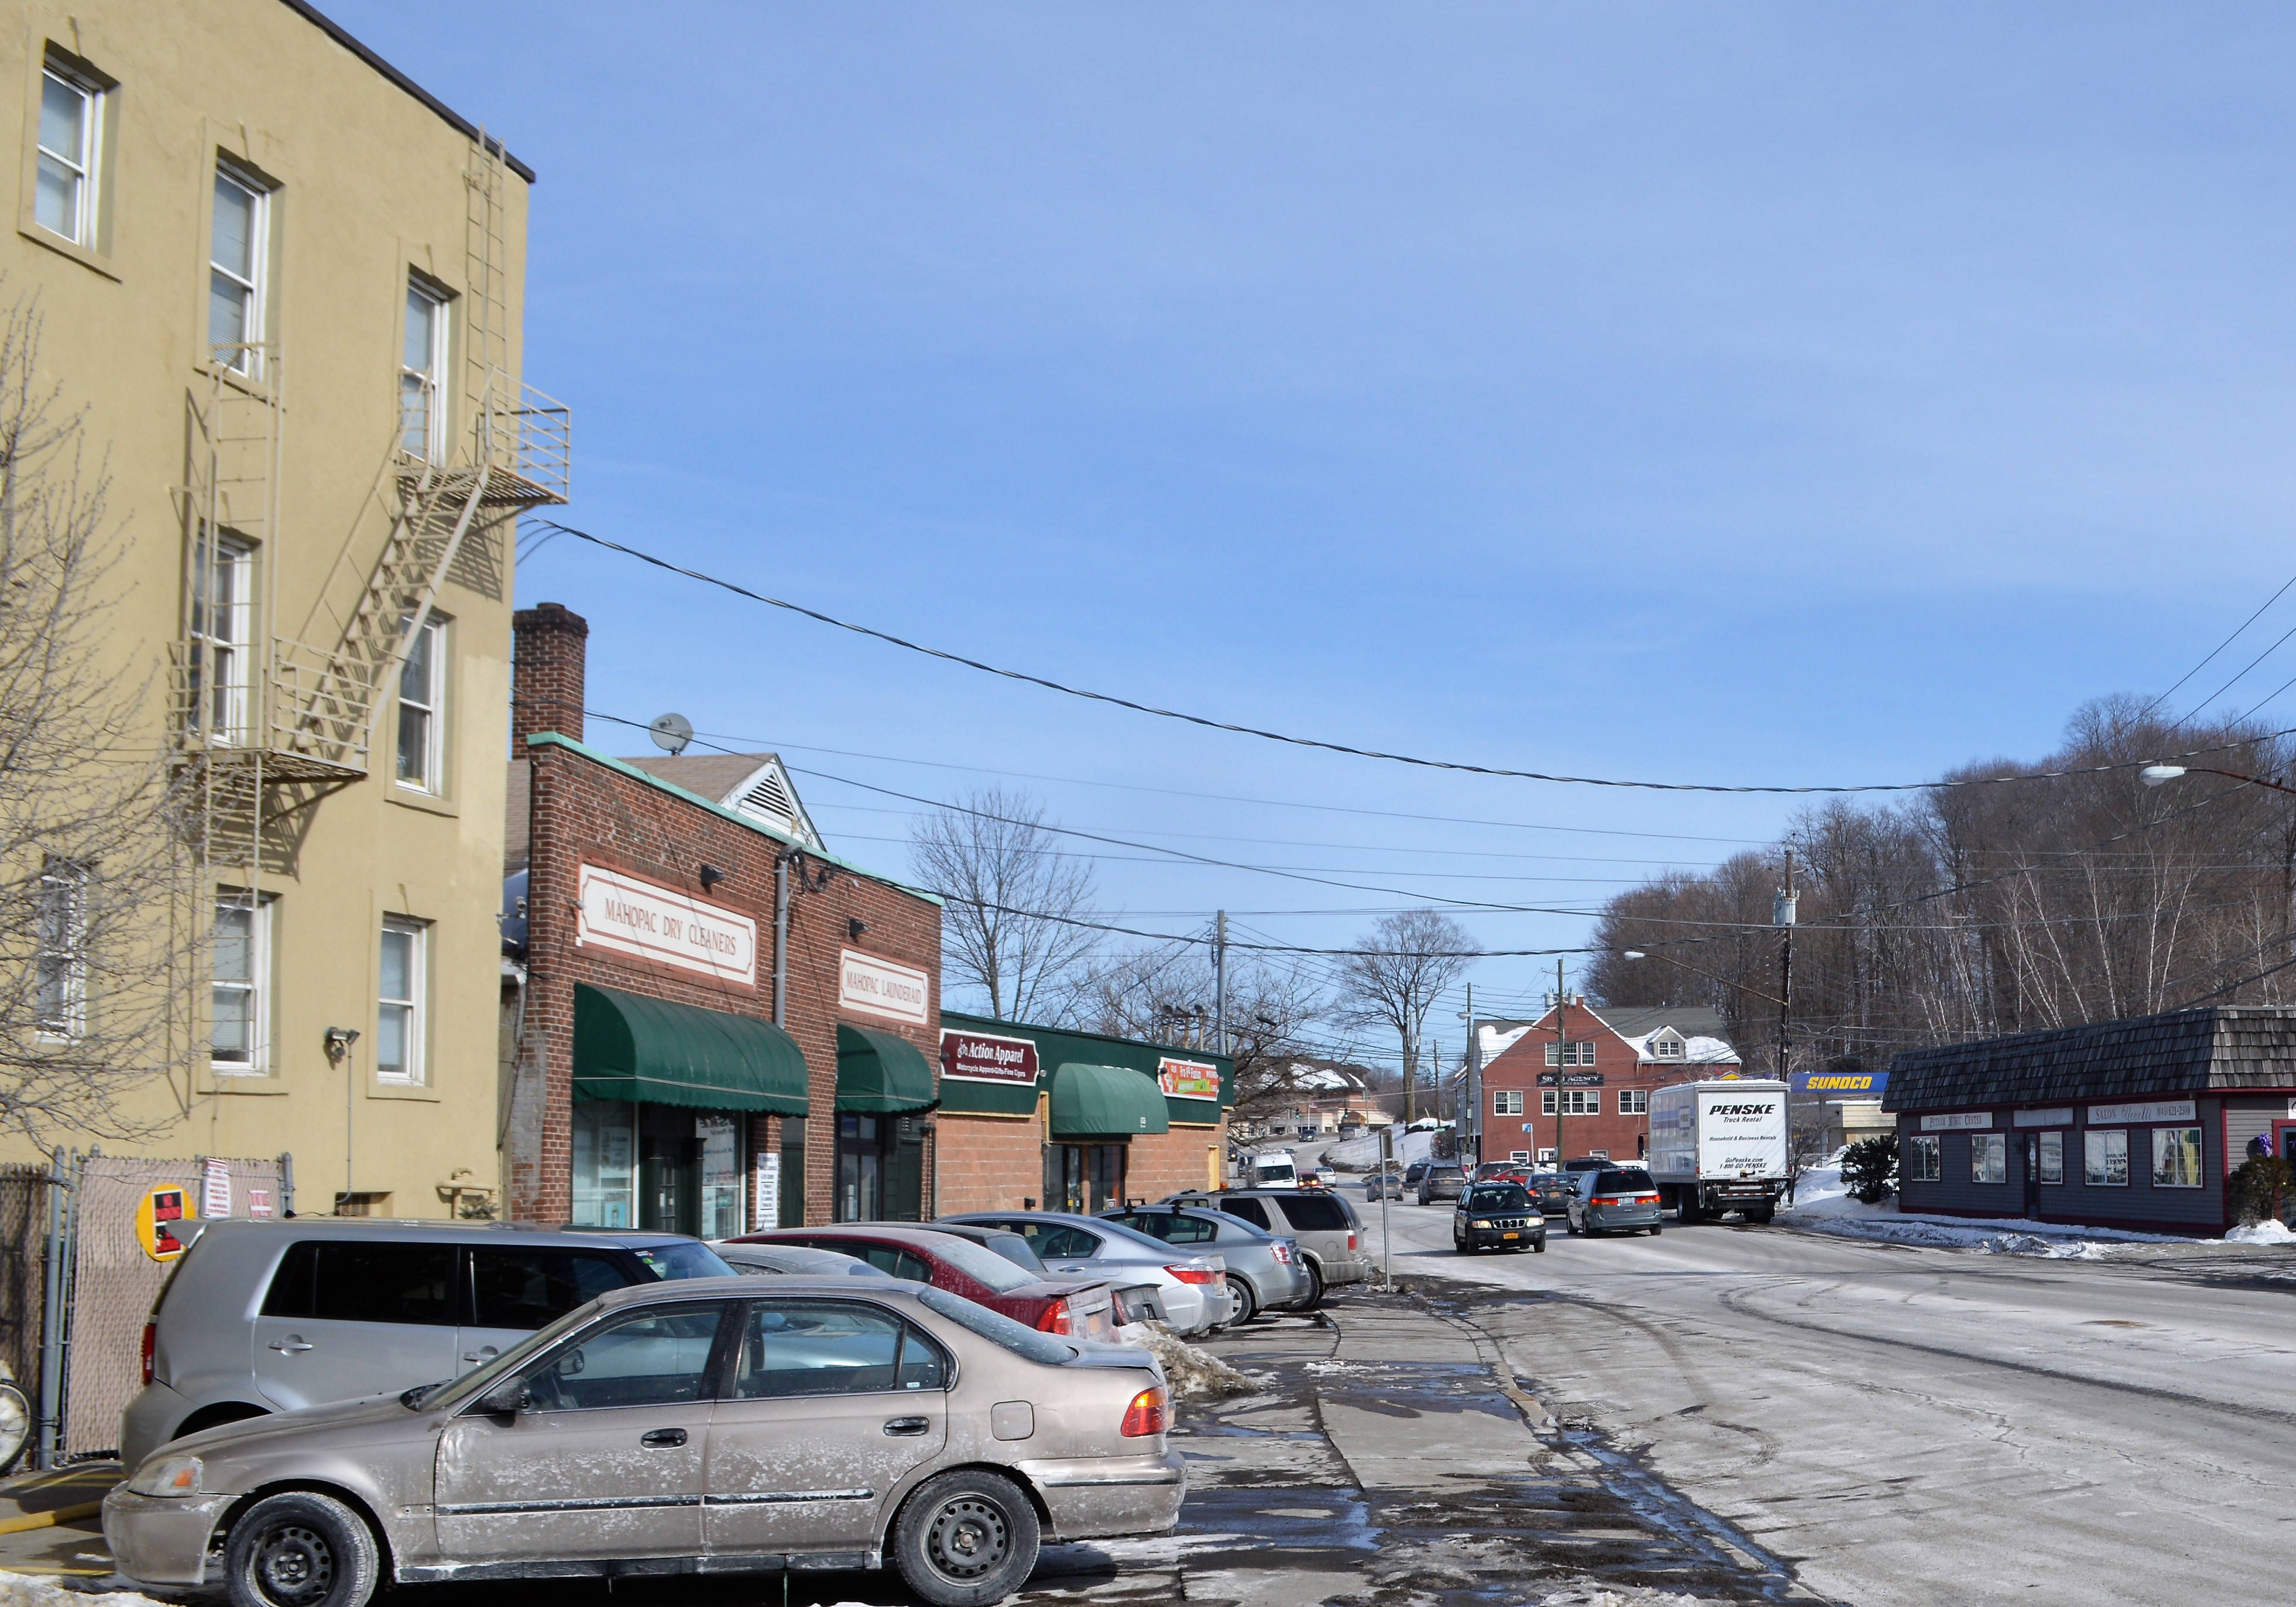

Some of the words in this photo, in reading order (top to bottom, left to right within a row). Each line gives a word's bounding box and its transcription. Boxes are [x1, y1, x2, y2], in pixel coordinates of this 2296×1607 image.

[605, 898, 657, 933] MAHOPAC
[663, 916, 683, 940] DRY
[689, 924, 736, 955] CLEANERS
[846, 971, 878, 995] MAHOPAC
[881, 979, 921, 1005] LAUNDERAID
[968, 1042, 994, 1059] Action
[994, 1045, 1024, 1065] Apparel
[1806, 1076, 1873, 1089] SUNOCO
[1709, 1104, 1776, 1115] PENSKE
[2095, 1108, 2116, 1121] SALON
